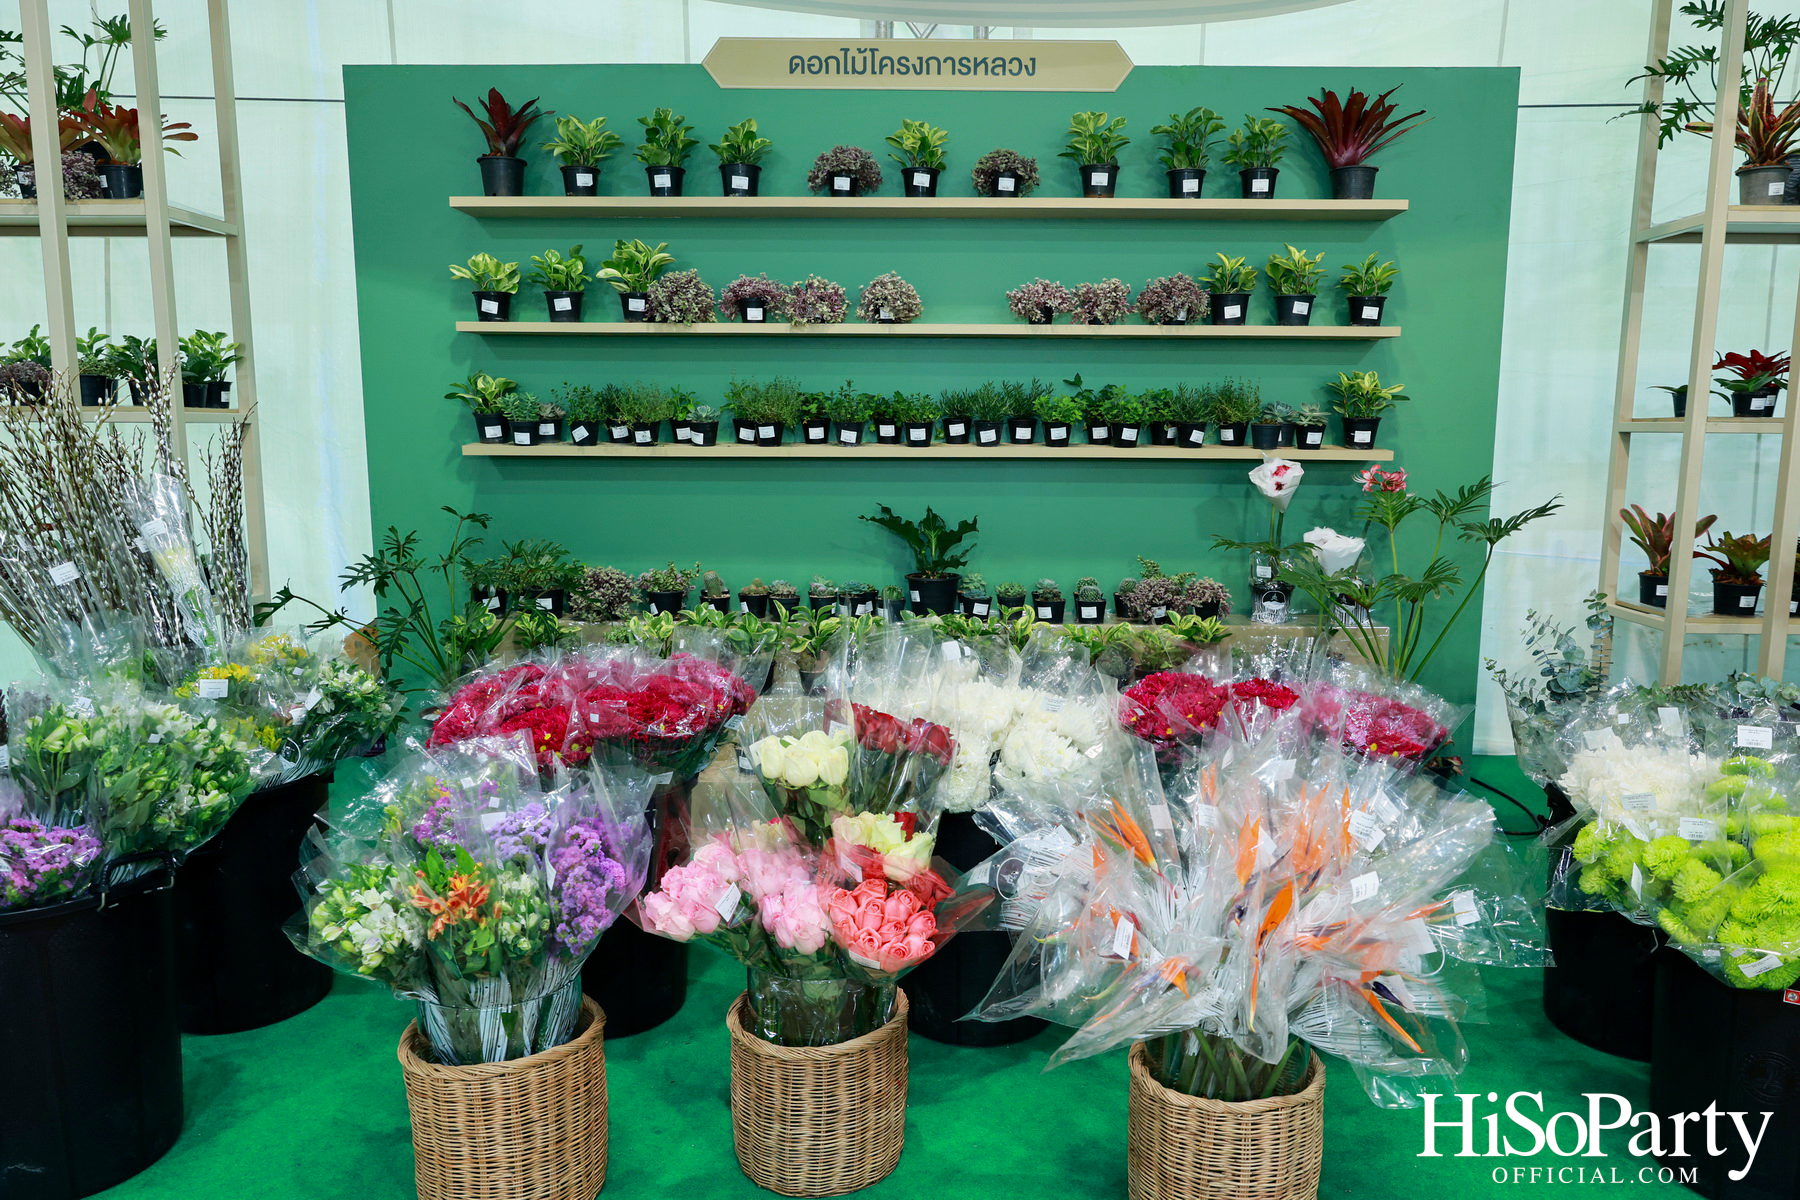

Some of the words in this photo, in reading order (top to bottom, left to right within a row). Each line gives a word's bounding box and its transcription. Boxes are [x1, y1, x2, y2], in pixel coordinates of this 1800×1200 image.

[788, 47, 1037, 77] ดอกไม้โครงการหลวง
